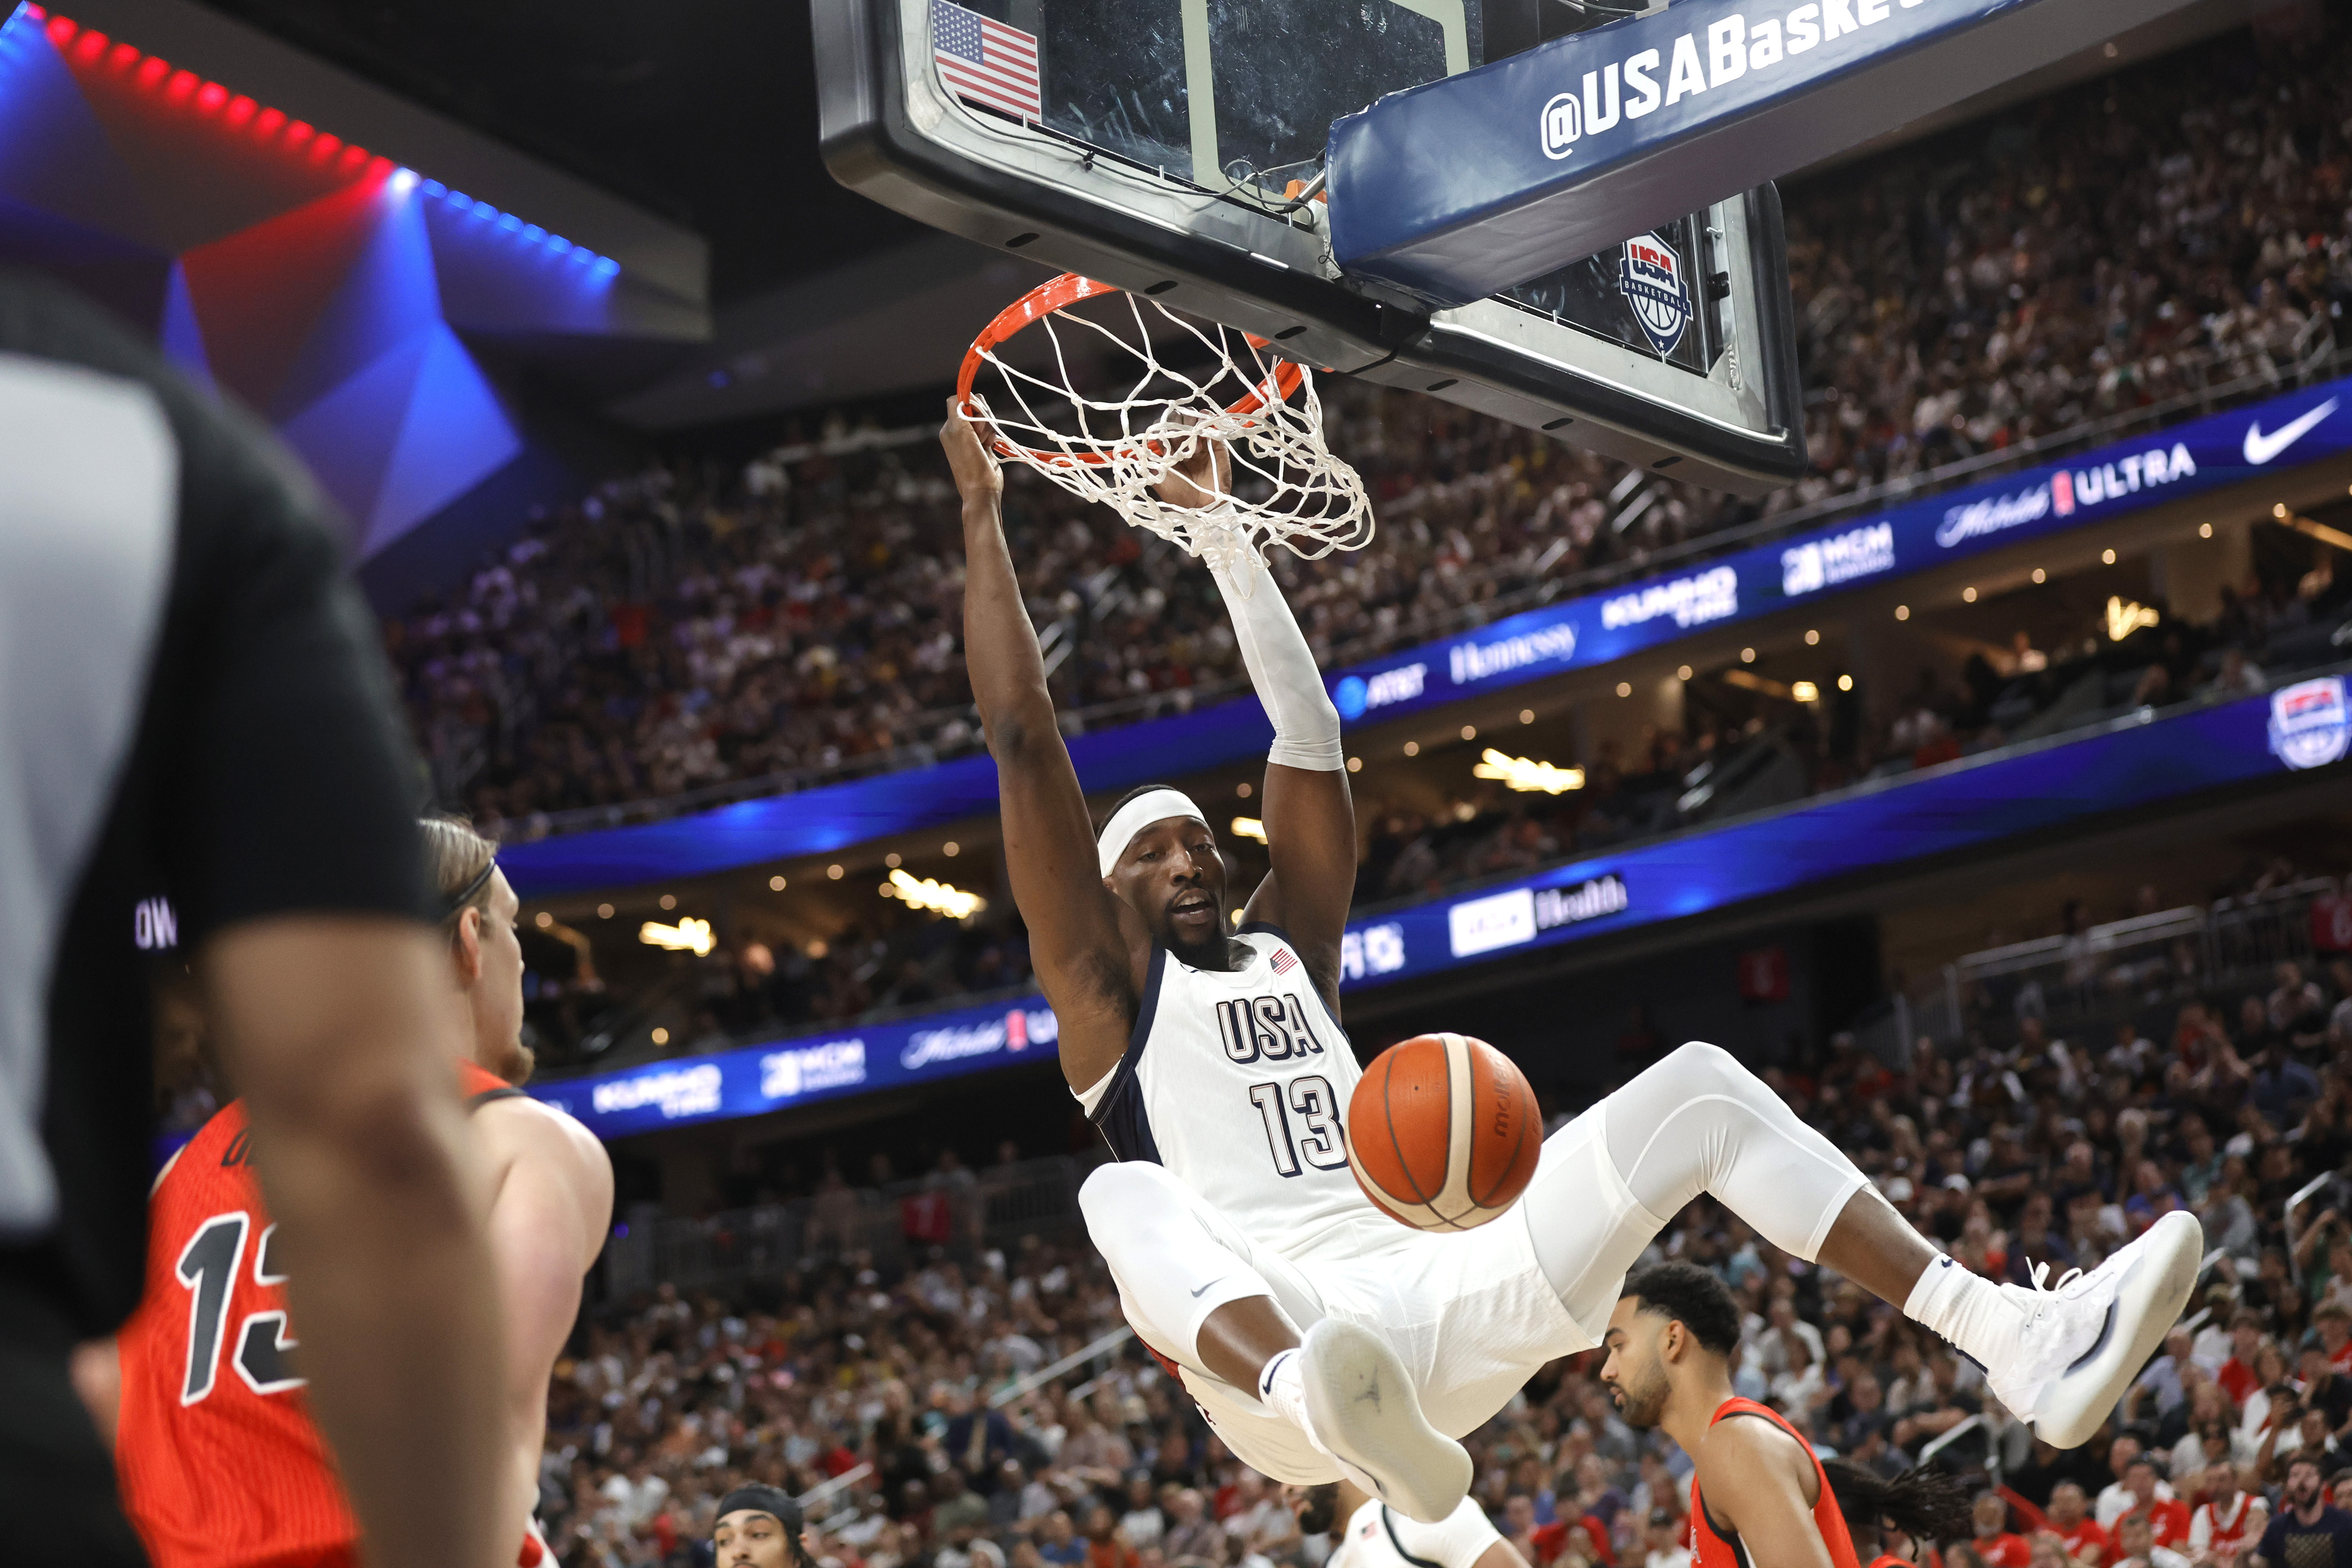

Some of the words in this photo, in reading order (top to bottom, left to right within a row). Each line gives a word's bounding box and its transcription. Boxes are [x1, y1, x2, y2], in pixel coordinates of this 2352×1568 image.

[1541, 0, 1923, 160] @USABaske
[1624, 280, 1687, 311] BASKETBALL
[1630, 244, 1676, 289] USA
[2075, 441, 2196, 505] ULTRA
[1217, 993, 1324, 1063] USA
[1250, 1075, 1351, 1178] 13
